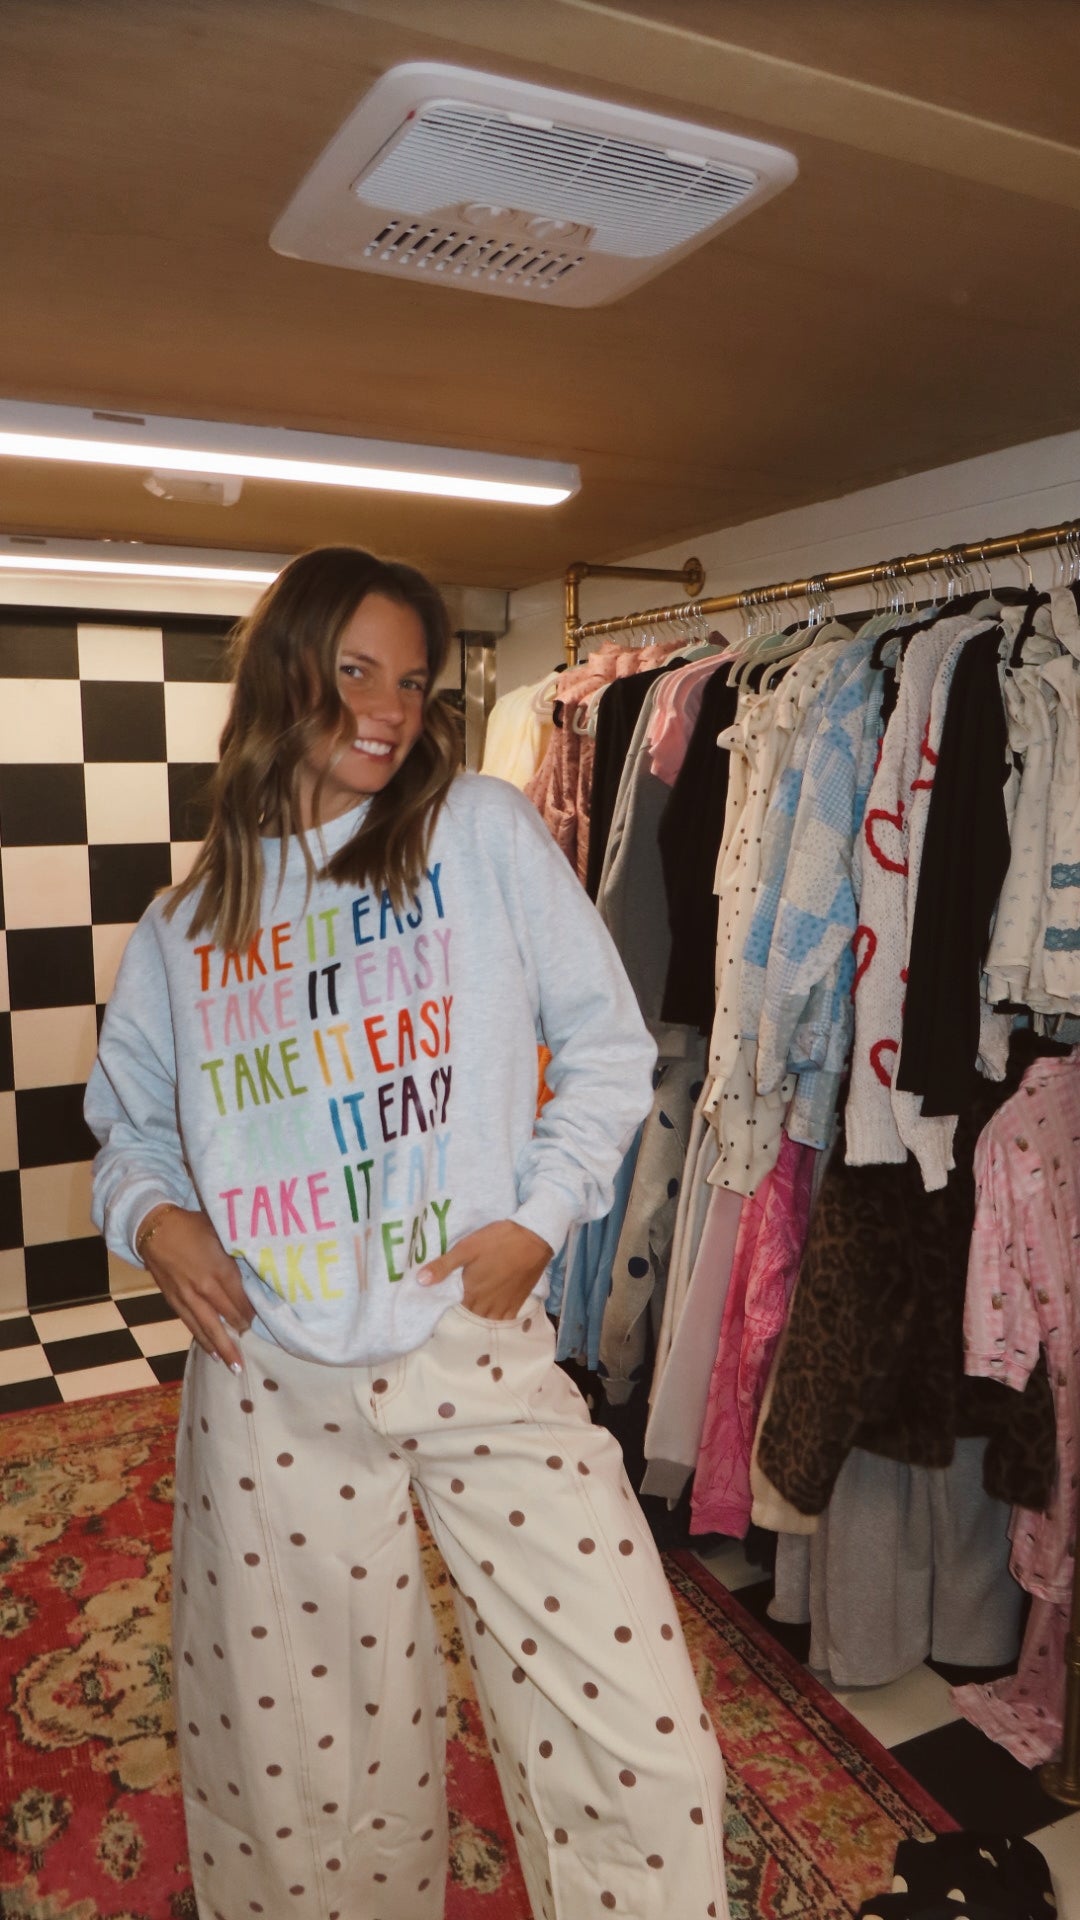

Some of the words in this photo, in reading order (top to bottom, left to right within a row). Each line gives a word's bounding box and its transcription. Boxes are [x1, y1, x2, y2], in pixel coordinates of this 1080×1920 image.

[194, 922, 293, 991] TAKE
[306, 907, 340, 963] IT
[195, 977, 297, 1051] TAKE
[308, 962, 341, 1020] IT
[355, 927, 452, 1008] EASY
[201, 1037, 308, 1116] TAKE
[313, 1023, 355, 1086] IT
[363, 995, 454, 1073] EASY
[213, 1104, 321, 1182] TAKE
[328, 1091, 368, 1155] IT
[378, 1065, 452, 1143] EASY
[219, 1171, 337, 1242] TAKE
[343, 1159, 375, 1223] IT
[381, 1132, 452, 1209] EAY
[231, 1240, 344, 1304] AKE
